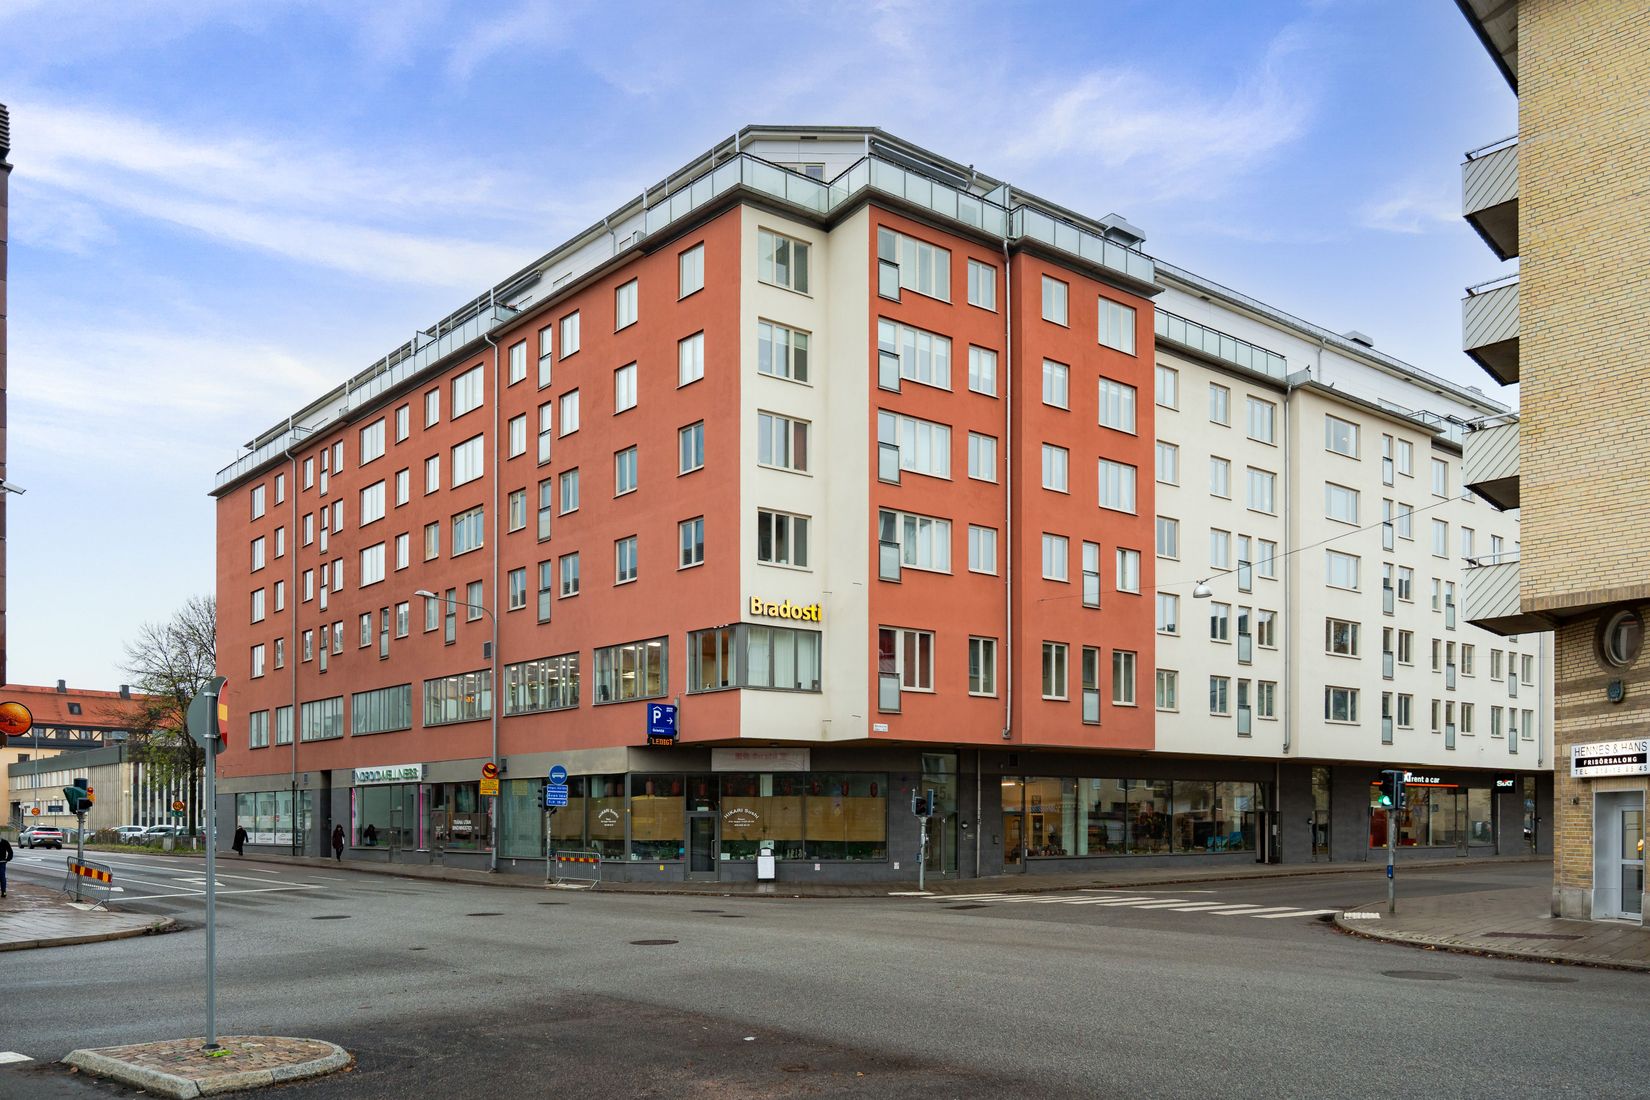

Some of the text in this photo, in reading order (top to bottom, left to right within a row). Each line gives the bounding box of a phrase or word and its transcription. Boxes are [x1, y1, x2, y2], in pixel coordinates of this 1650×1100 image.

[750, 596, 822, 623] Bradosti
[653, 710, 662, 723] P
[1574, 741, 1648, 757] HENNES & HANS
[1583, 756, 1638, 766] FRISÖRSALONG
[724, 808, 760, 820] HIKARI Sushi
